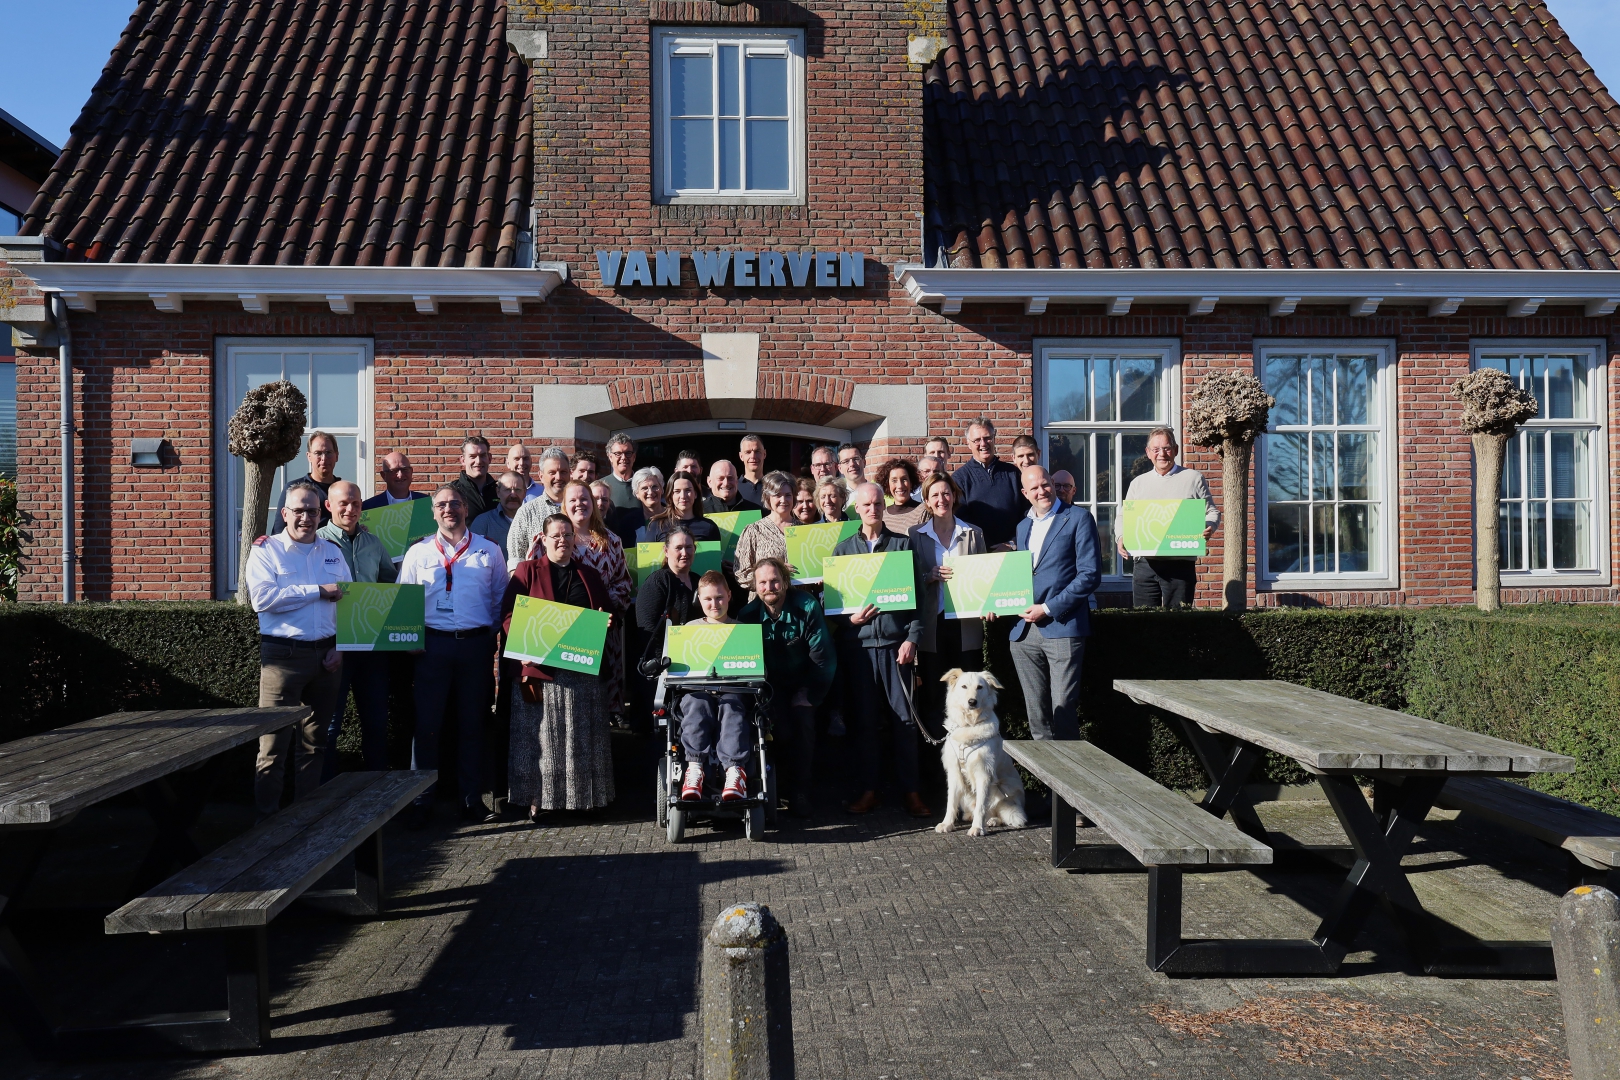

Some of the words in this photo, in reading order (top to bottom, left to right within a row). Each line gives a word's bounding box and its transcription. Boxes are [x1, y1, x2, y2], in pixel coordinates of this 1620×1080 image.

[596, 250, 681, 286] VAN
[692, 250, 865, 287] WERVEN
[1169, 540, 1200, 549] €3000
[871, 586, 912, 594] nieuwjaarsgift
[989, 588, 1031, 597] nieuwjaarsgift
[876, 593, 909, 604] €3000
[994, 597, 1027, 608] €3000
[383, 624, 423, 632] nieuwjaarsgift
[388, 632, 419, 642] €3000
[557, 642, 600, 656] nieuwjaarsgift
[560, 651, 594, 666] €3000
[722, 661, 757, 669] €3000
